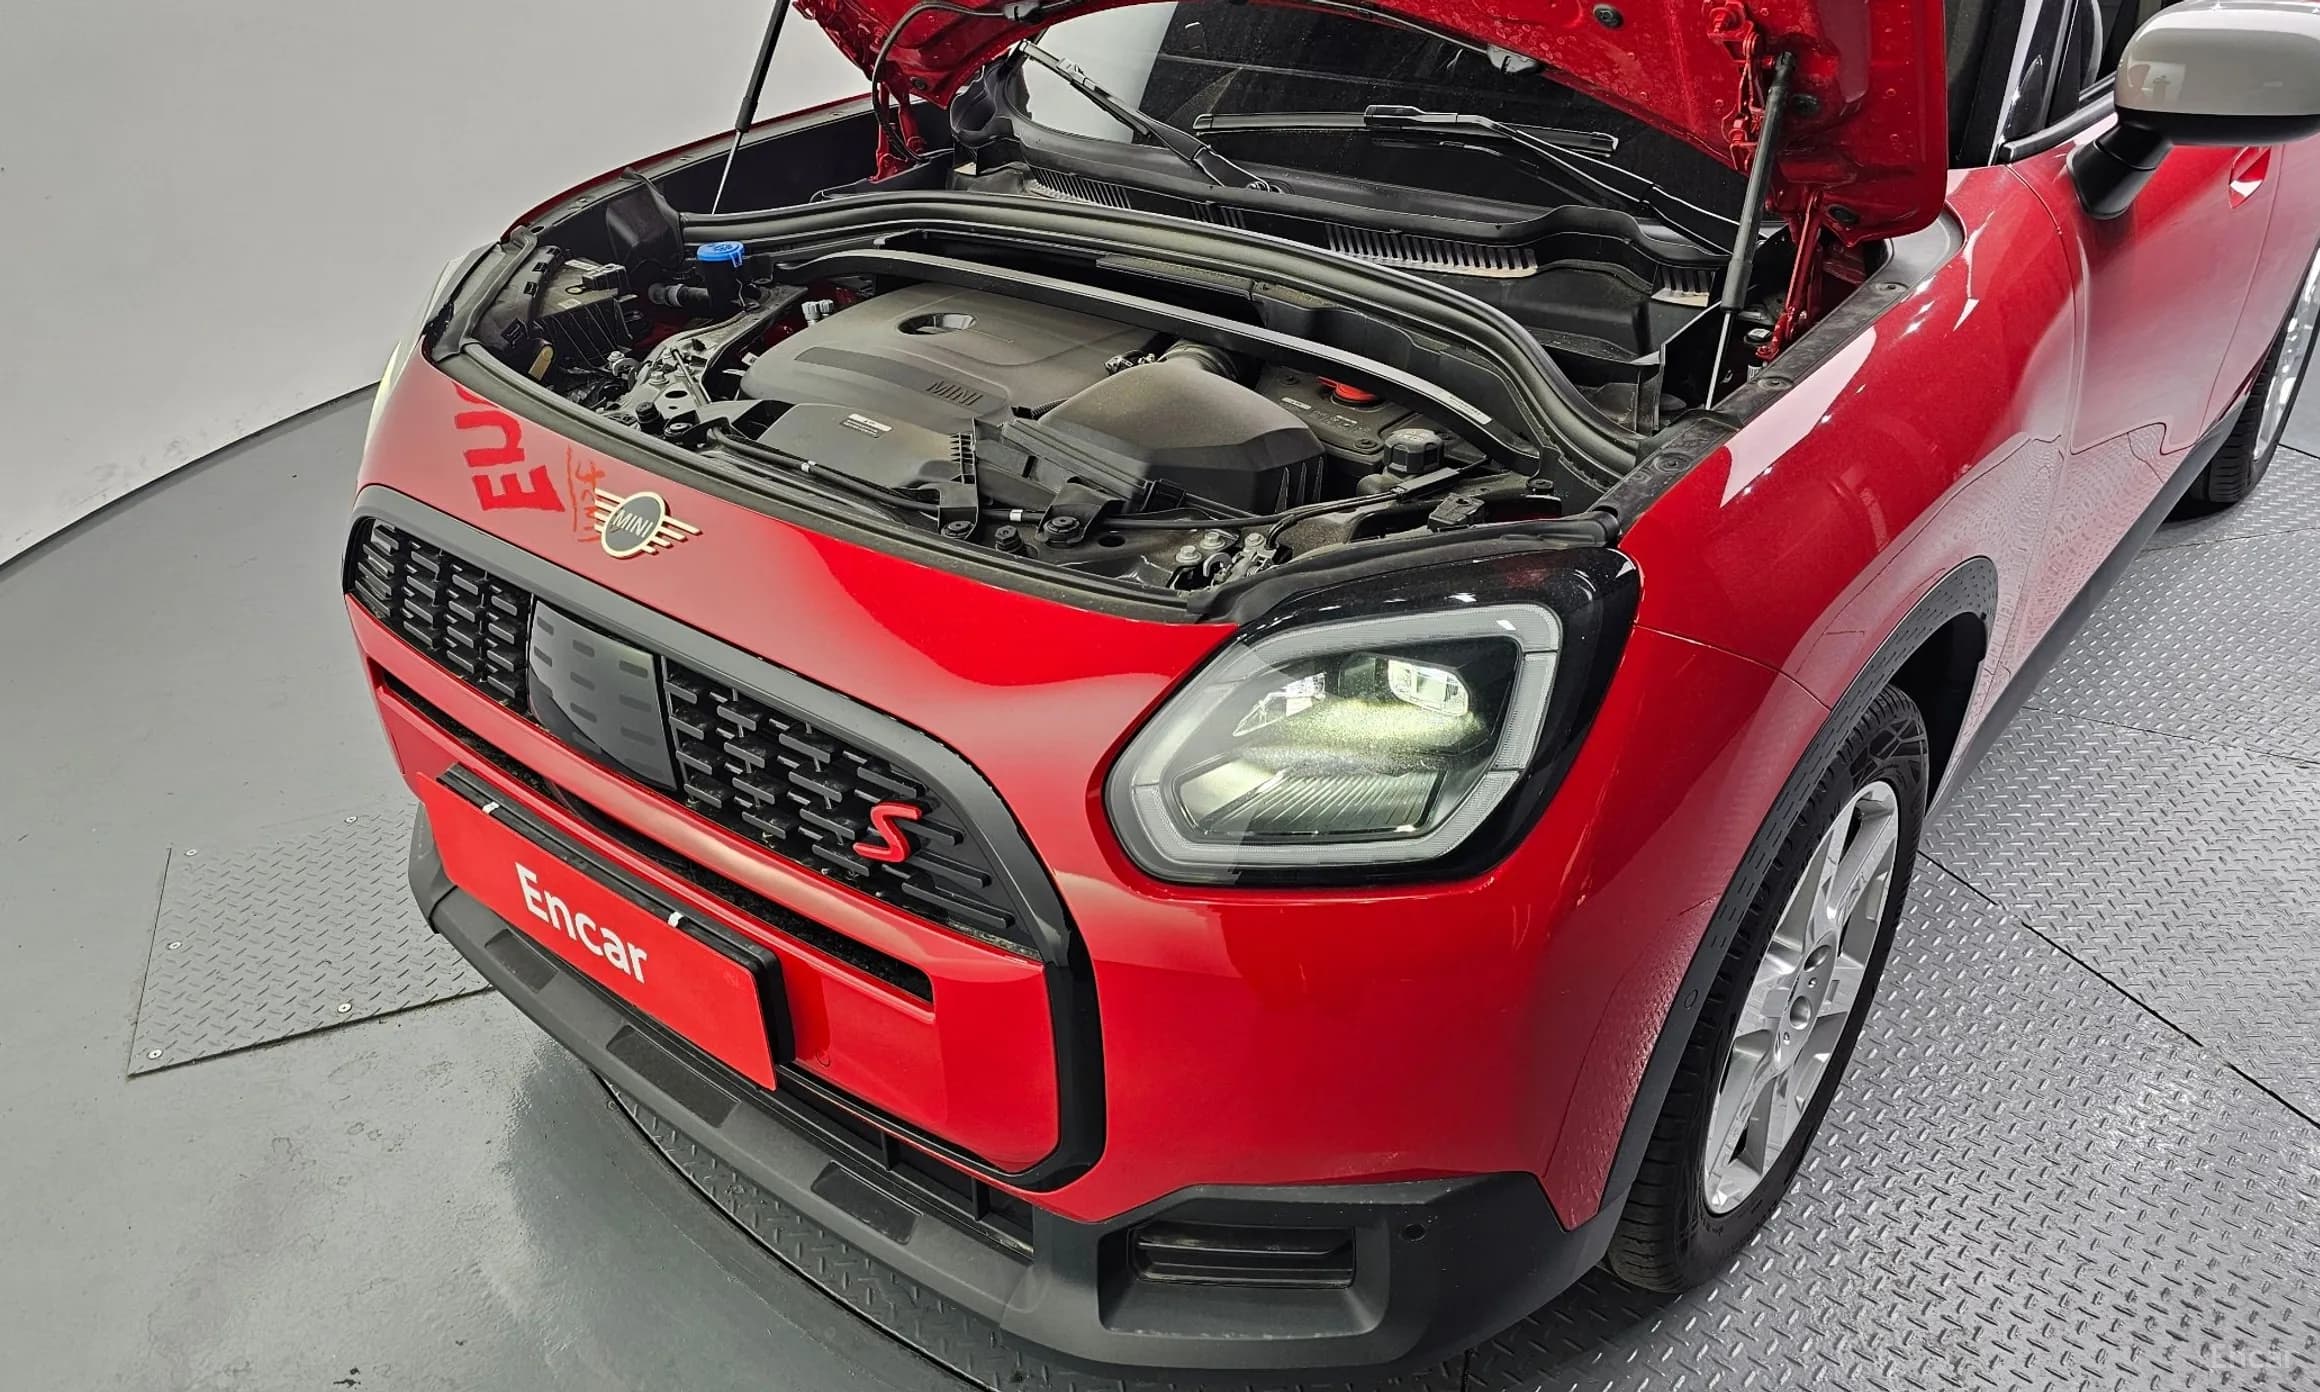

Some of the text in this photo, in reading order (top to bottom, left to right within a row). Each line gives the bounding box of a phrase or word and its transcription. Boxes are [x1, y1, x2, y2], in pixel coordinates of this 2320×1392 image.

[924, 380, 984, 406] MINI
[612, 509, 654, 538] MINI
[852, 801, 922, 863] S
[515, 862, 648, 984] Encar
